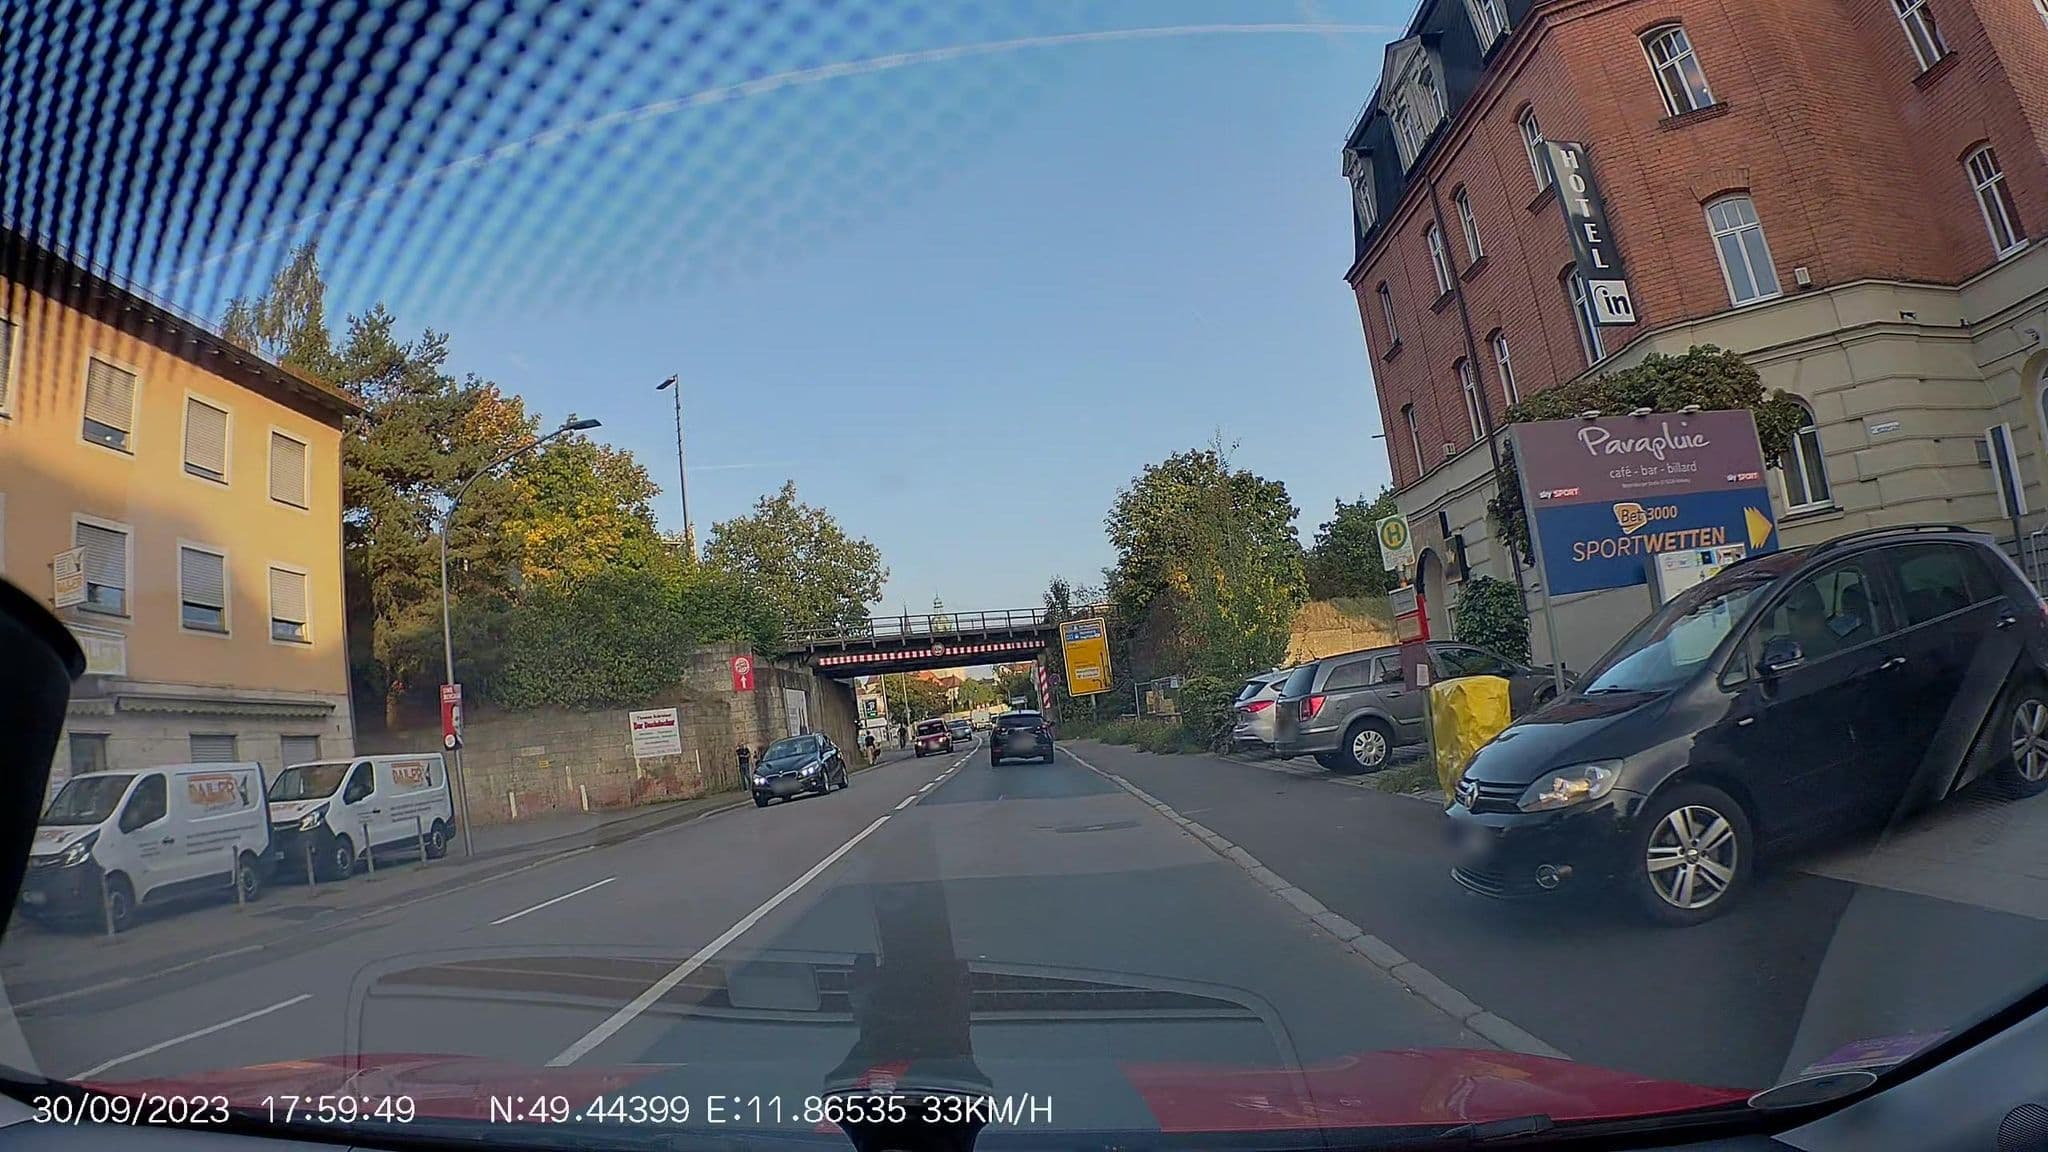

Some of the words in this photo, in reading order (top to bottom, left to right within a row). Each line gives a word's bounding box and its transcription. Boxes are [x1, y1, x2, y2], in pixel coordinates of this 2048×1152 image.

[1560, 149, 1610, 269] HOTEL
[1578, 421, 1710, 461] Parapluie
[1609, 466, 1632, 479] café
[1640, 464, 1658, 476] bar
[1667, 460, 1698, 474] billard
[1572, 526, 1726, 563] SPORTWETTEN
